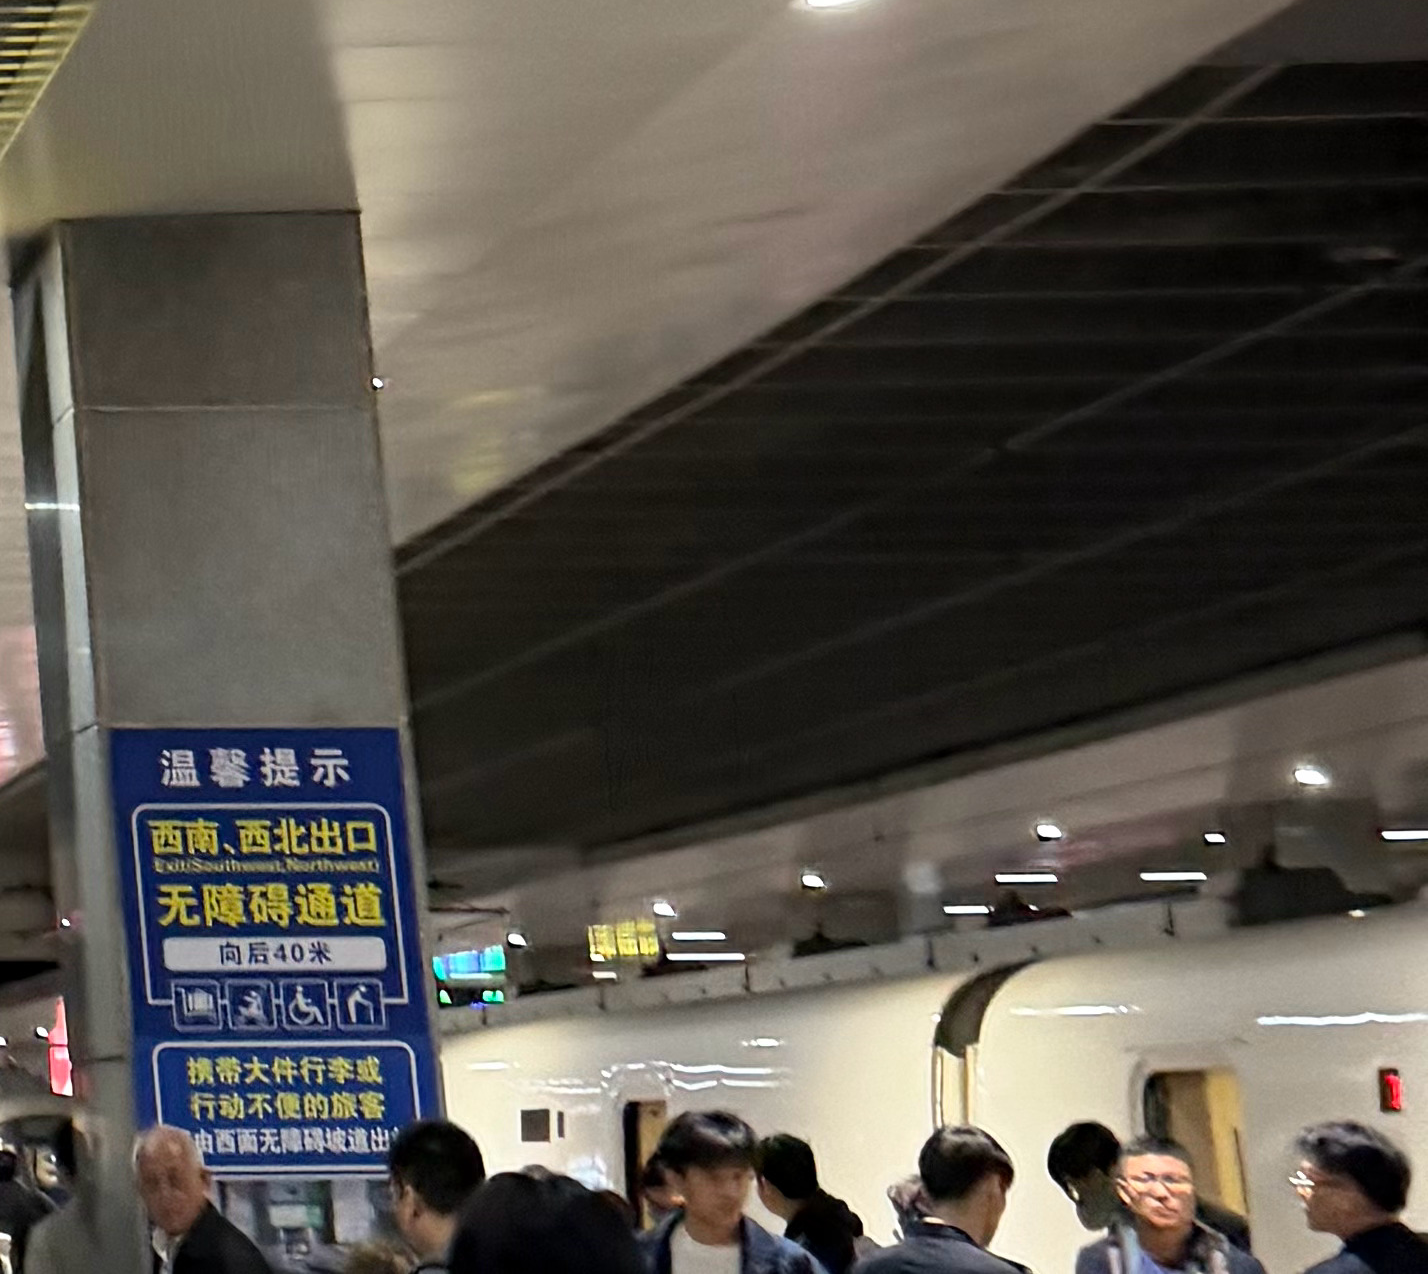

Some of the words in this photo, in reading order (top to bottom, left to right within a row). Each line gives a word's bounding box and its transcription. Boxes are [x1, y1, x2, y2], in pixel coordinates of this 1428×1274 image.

[160, 748, 350, 788] 温馨提示
[148, 818, 377, 856] 西南、西北出口
[158, 883, 385, 928] 无障碍通道
[220, 942, 332, 966] 向后40米
